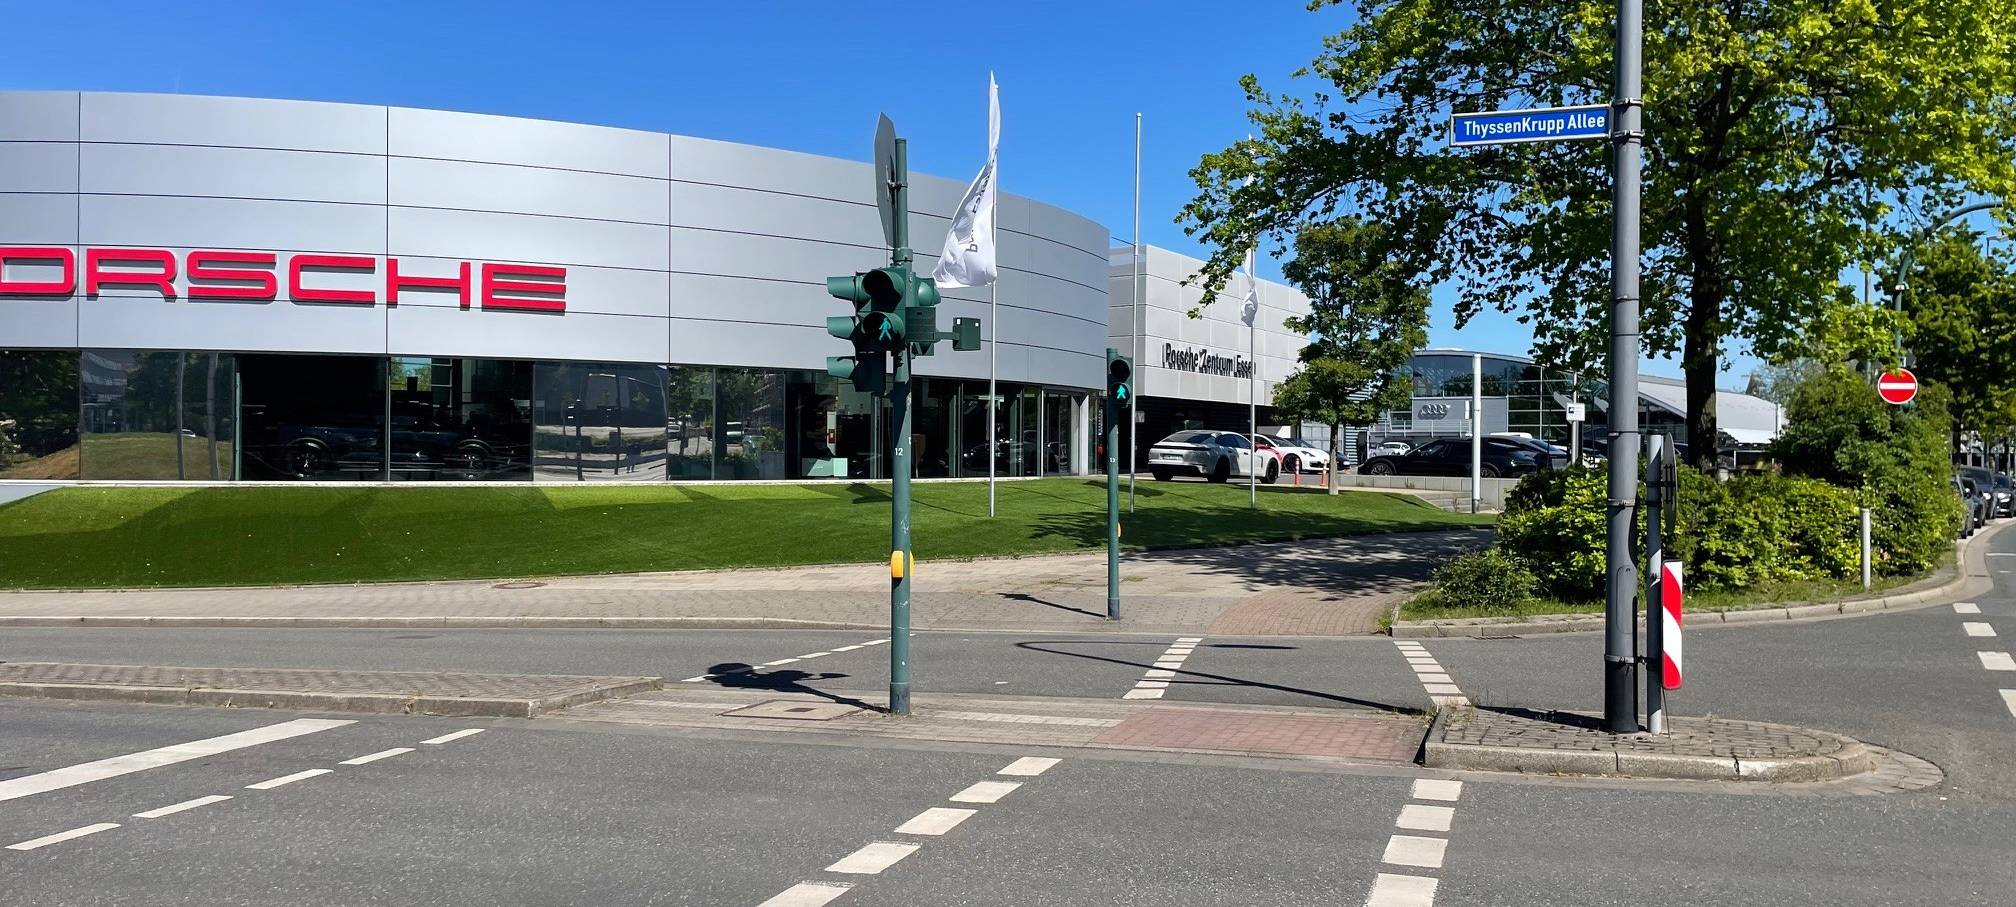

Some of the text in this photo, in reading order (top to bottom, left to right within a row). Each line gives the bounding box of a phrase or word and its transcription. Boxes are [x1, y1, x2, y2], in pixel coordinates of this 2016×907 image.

[1464, 113, 1605, 138] ThyssenKrupp Allee
[1165, 342, 1200, 370] Porsche
[1200, 348, 1234, 375] Zentrum
[894, 447, 904, 456] 12
